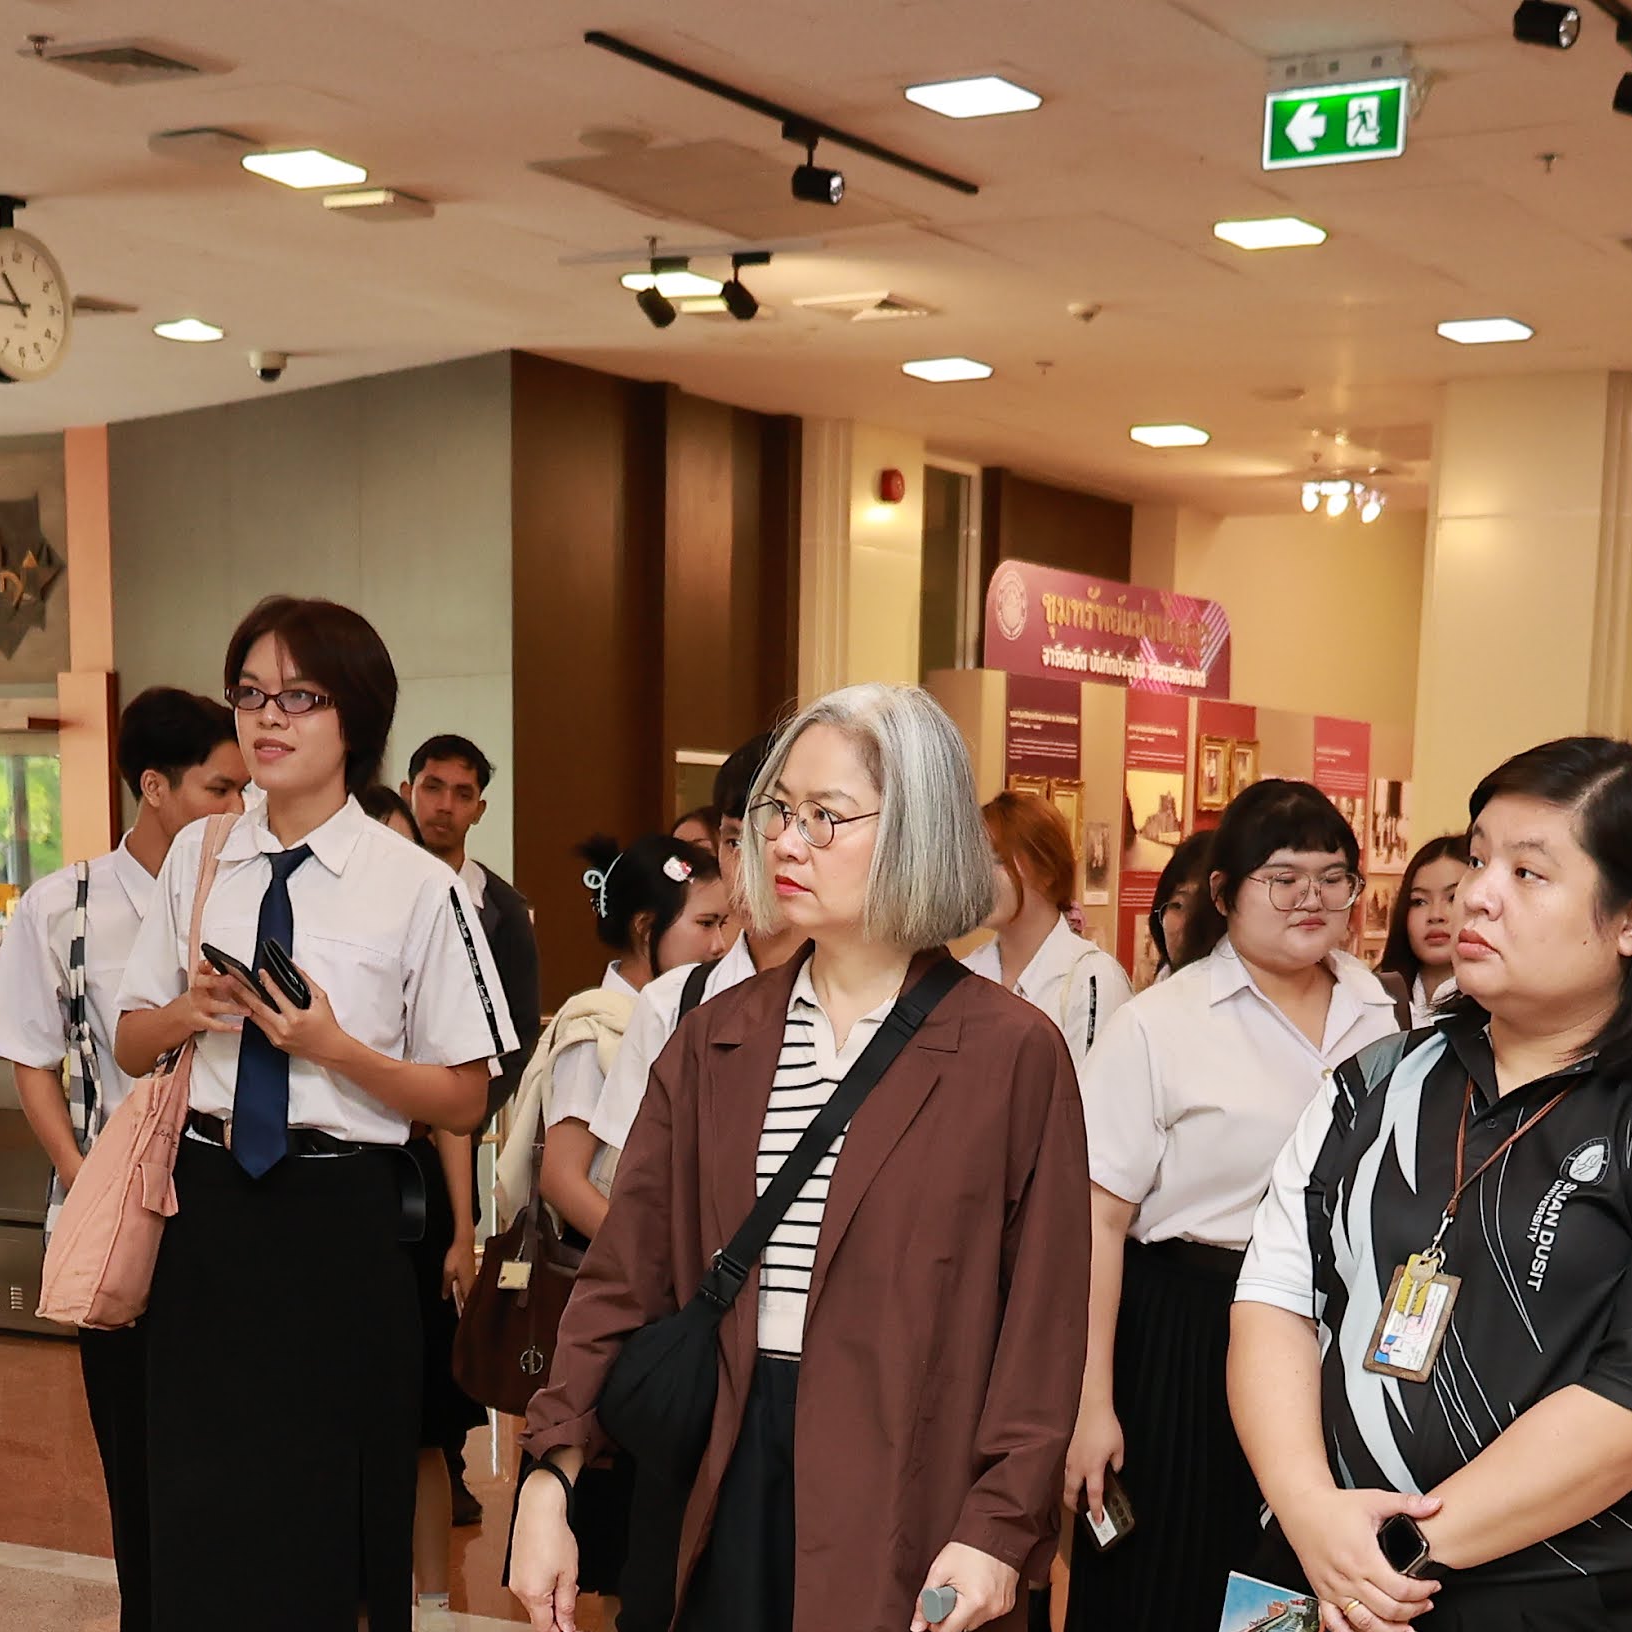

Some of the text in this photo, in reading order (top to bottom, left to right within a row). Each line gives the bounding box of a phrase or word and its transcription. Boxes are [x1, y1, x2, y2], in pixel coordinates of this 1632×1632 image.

[1527, 1179, 1566, 1243] UNIVERSITY
[1527, 1182, 1578, 1292] SUAN DUSIT
